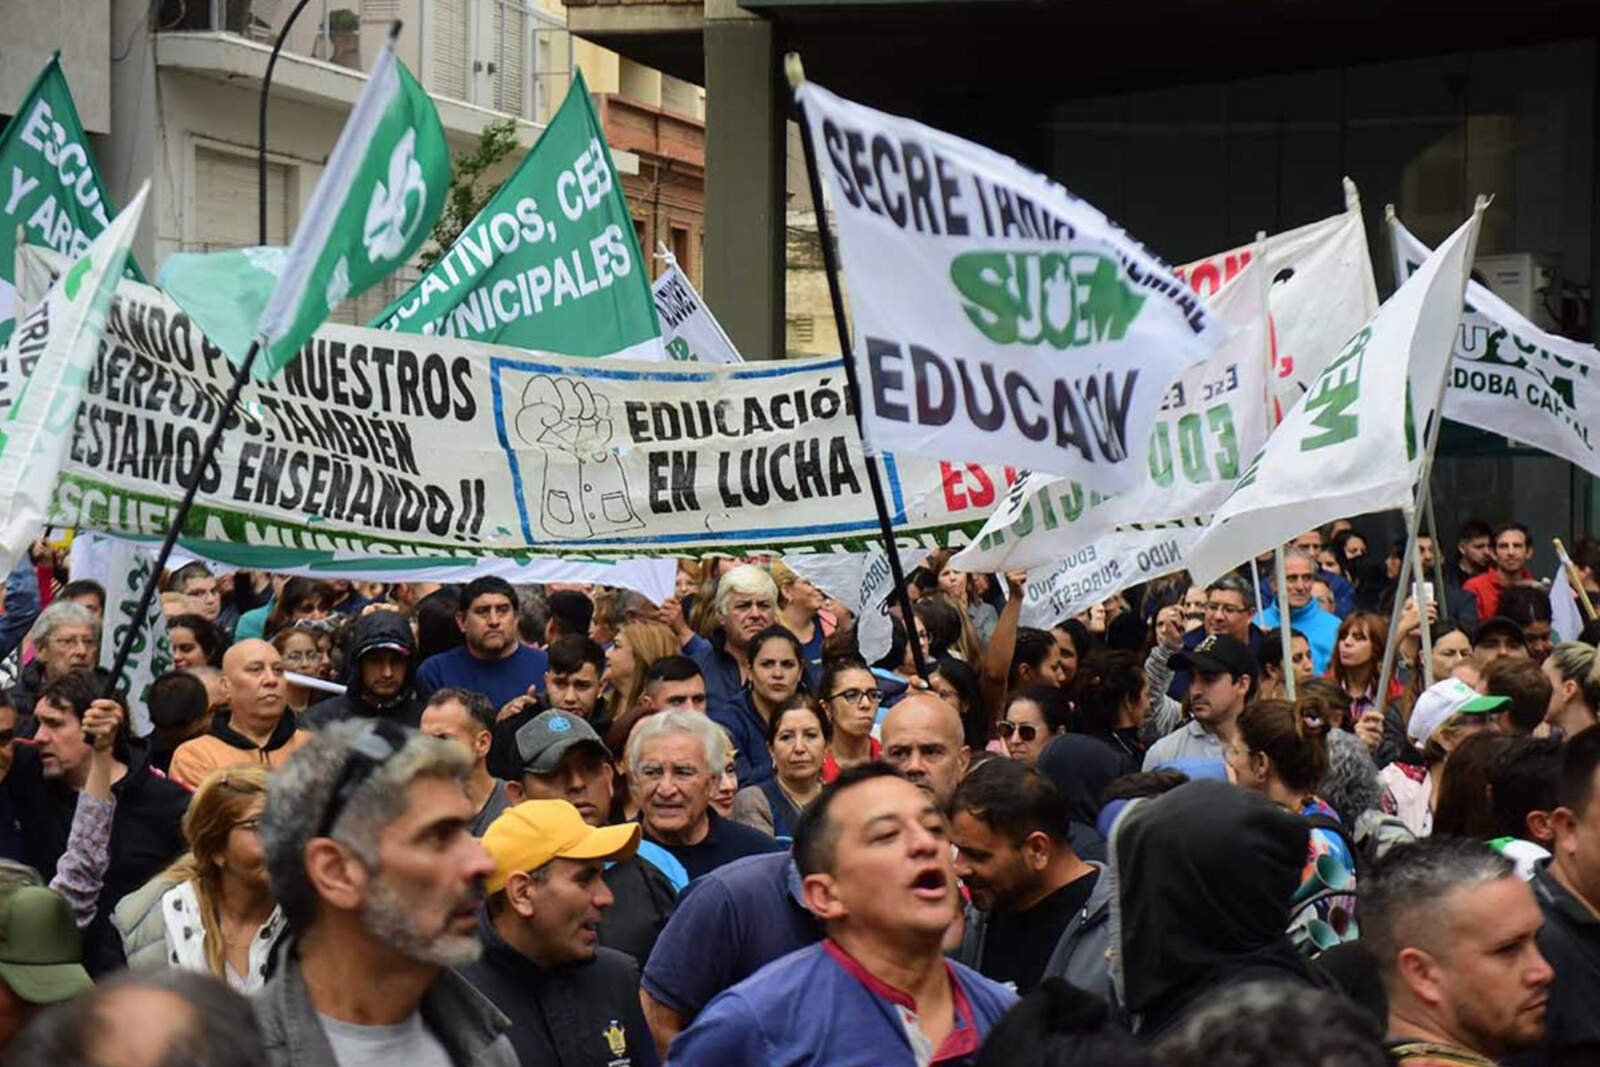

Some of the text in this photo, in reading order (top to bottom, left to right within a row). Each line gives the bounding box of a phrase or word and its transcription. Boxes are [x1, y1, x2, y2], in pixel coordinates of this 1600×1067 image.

[4, 165, 39, 215] Y
[284, 338, 477, 421] NUESTROS
[1446, 366, 1519, 400] DOBA
[70, 400, 227, 496] ESTAMOS
[648, 436, 862, 514] EN LUCHA
